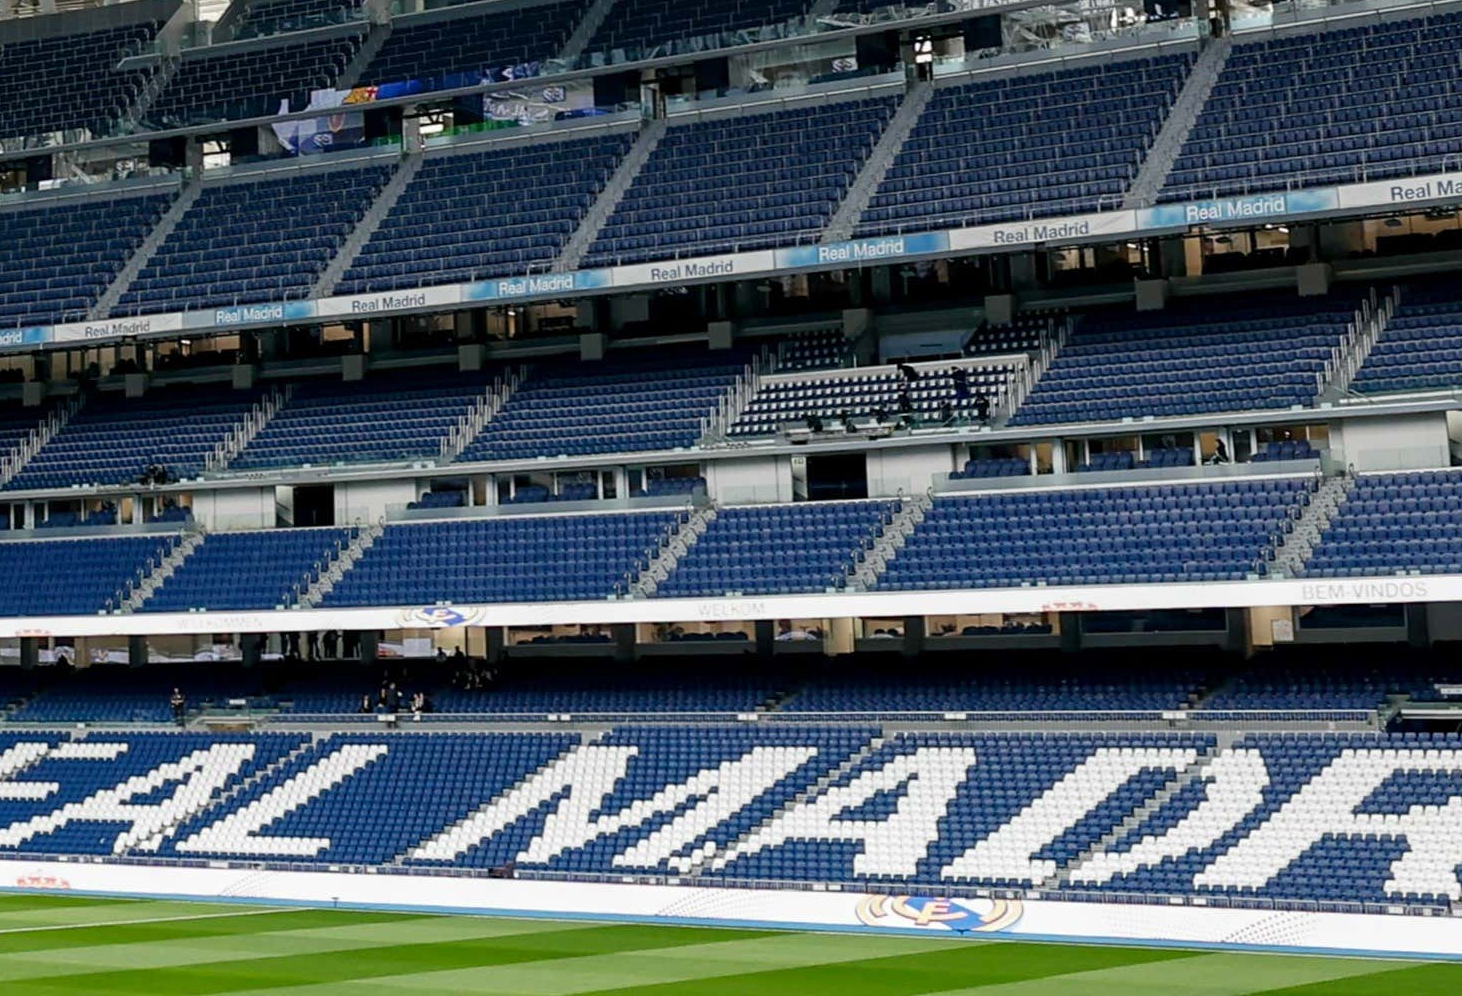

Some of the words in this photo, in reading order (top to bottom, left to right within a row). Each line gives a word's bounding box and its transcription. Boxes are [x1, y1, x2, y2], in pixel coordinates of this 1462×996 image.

[1390, 182, 1432, 202] Real
[1186, 202, 1223, 220] Real
[1227, 197, 1284, 216] Madrid
[994, 227, 1032, 245] Real
[1036, 222, 1089, 242] Madrid
[819, 245, 850, 262] Real
[855, 239, 904, 258] Madrid
[650, 265, 682, 282] Real
[686, 260, 733, 278] Madrid
[498, 280, 527, 297] Real
[532, 275, 573, 293] Madrid
[216, 307, 242, 323] Real
[245, 304, 283, 321] Madrid
[352, 297, 379, 312] Real
[383, 294, 425, 310] Madrid
[85, 323, 109, 338] Real
[112, 319, 150, 335] Madrid
[1302, 581, 1428, 600] BEM-VINDOS
